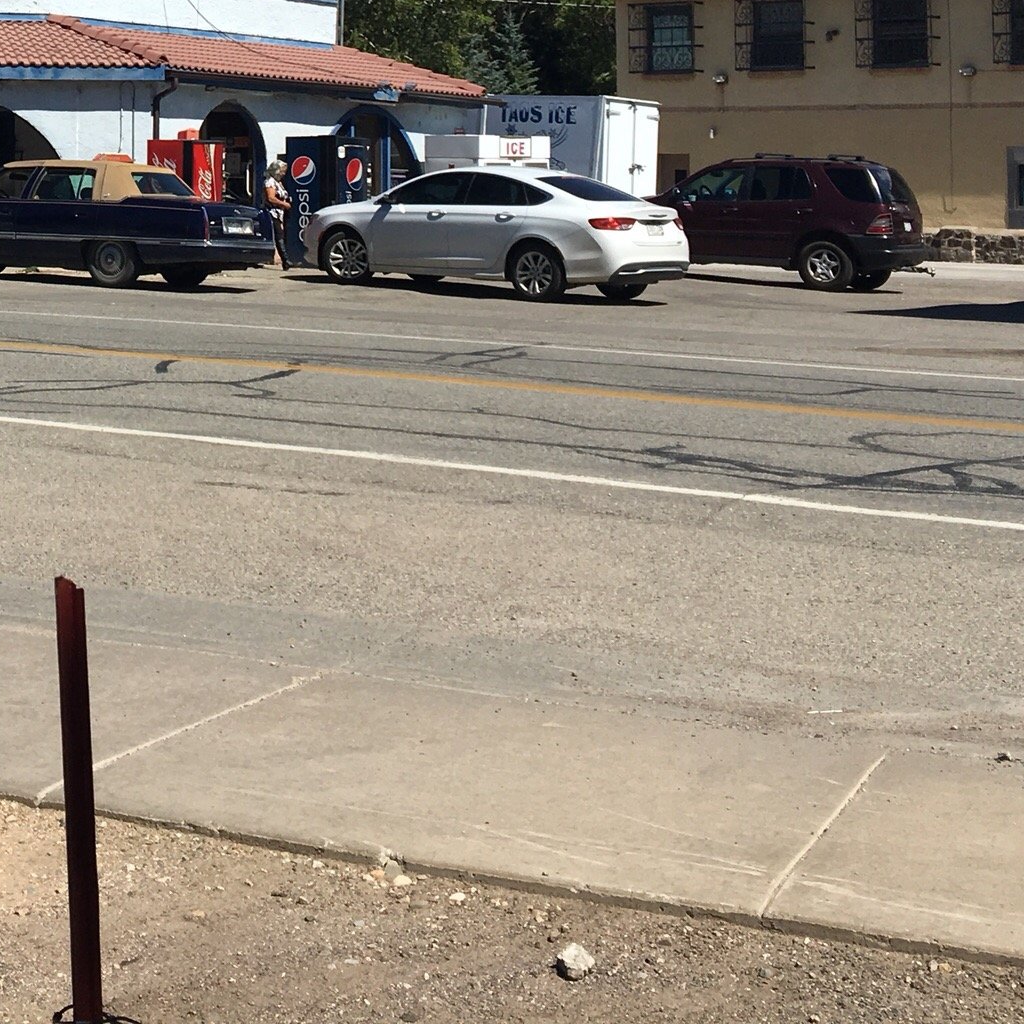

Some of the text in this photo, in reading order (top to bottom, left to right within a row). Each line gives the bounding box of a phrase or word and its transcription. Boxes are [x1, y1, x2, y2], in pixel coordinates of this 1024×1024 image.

[500, 105, 577, 125] TAOS ICE
[506, 142, 525, 155] ICE
